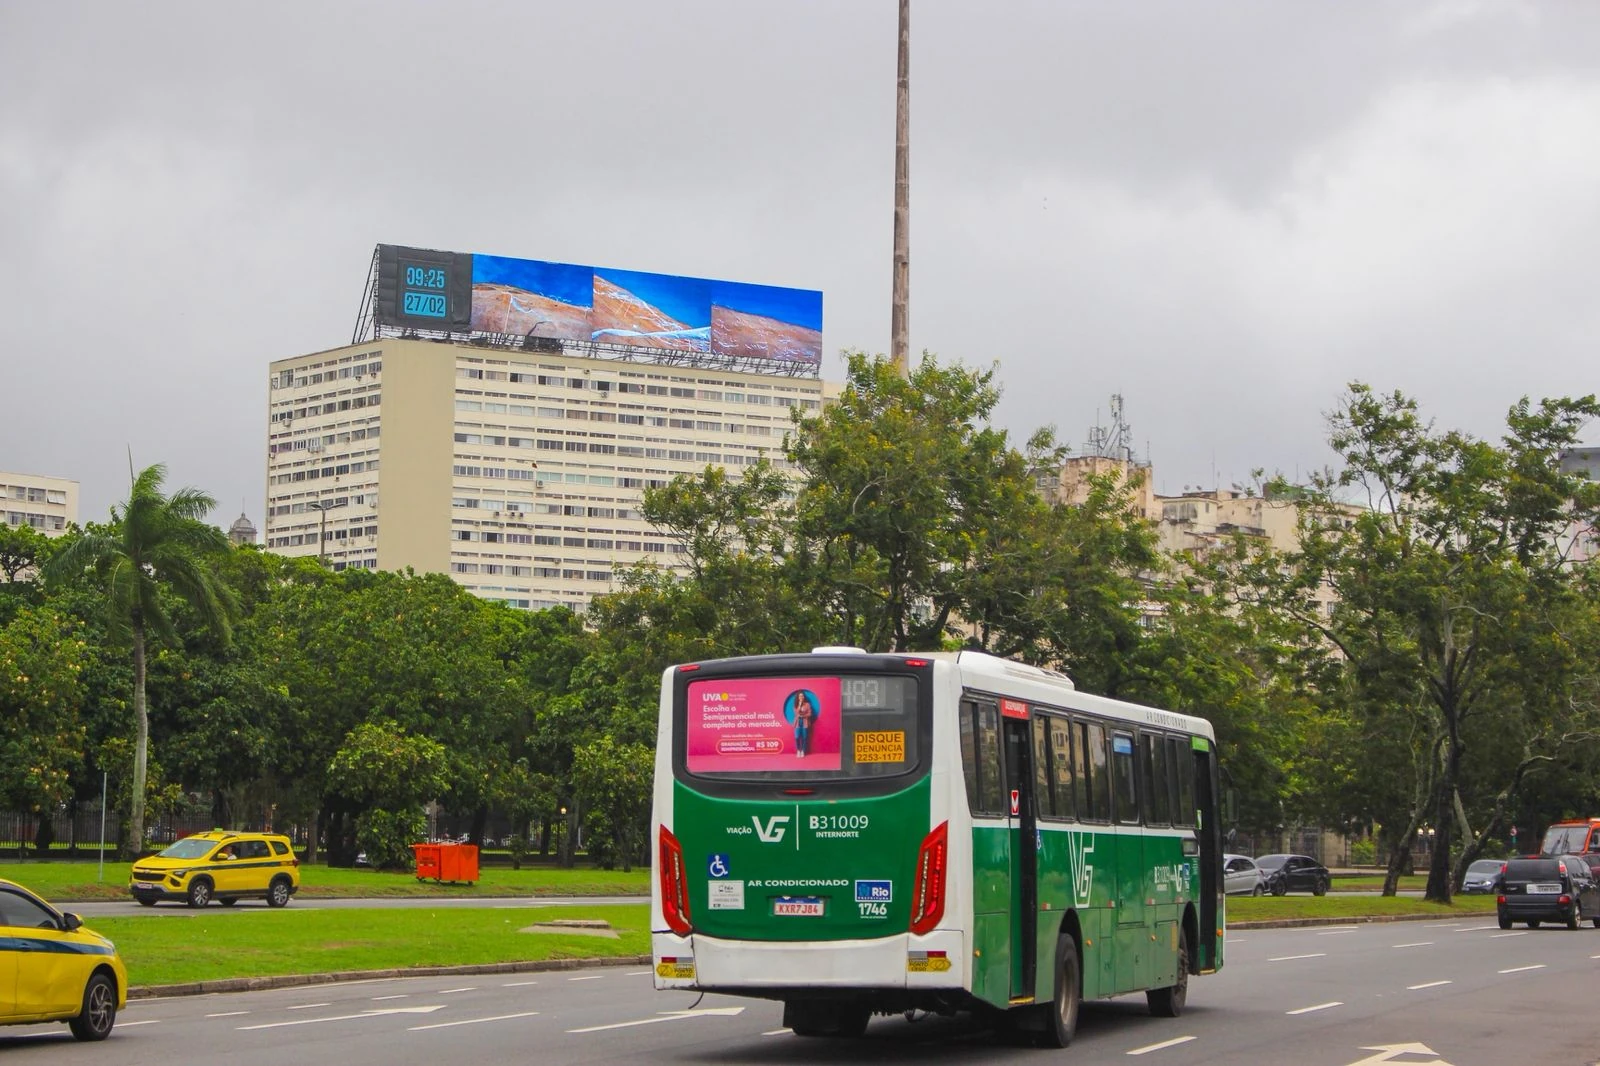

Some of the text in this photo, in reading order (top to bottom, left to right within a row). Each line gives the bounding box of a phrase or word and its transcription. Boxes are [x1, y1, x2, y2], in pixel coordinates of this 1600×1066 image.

[407, 267, 445, 288] 09:25
[406, 294, 444, 314] 27/02
[702, 693, 721, 702] UVA
[703, 704, 730, 712] Escolha
[703, 712, 757, 721] Semipresencial
[703, 720, 782, 730] completo do mercado.
[856, 733, 902, 743] DISQUE
[856, 744, 903, 753] DENUNCIA
[857, 753, 903, 761] 2253-1177
[809, 815, 869, 829] B31009
[726, 816, 790, 842] VIAÇÃO VG
[764, 879, 849, 887] CONDICIONADO
[871, 887, 889, 897] Rio
[778, 904, 818, 914] KXR7J84
[858, 902, 887, 915] 1746
